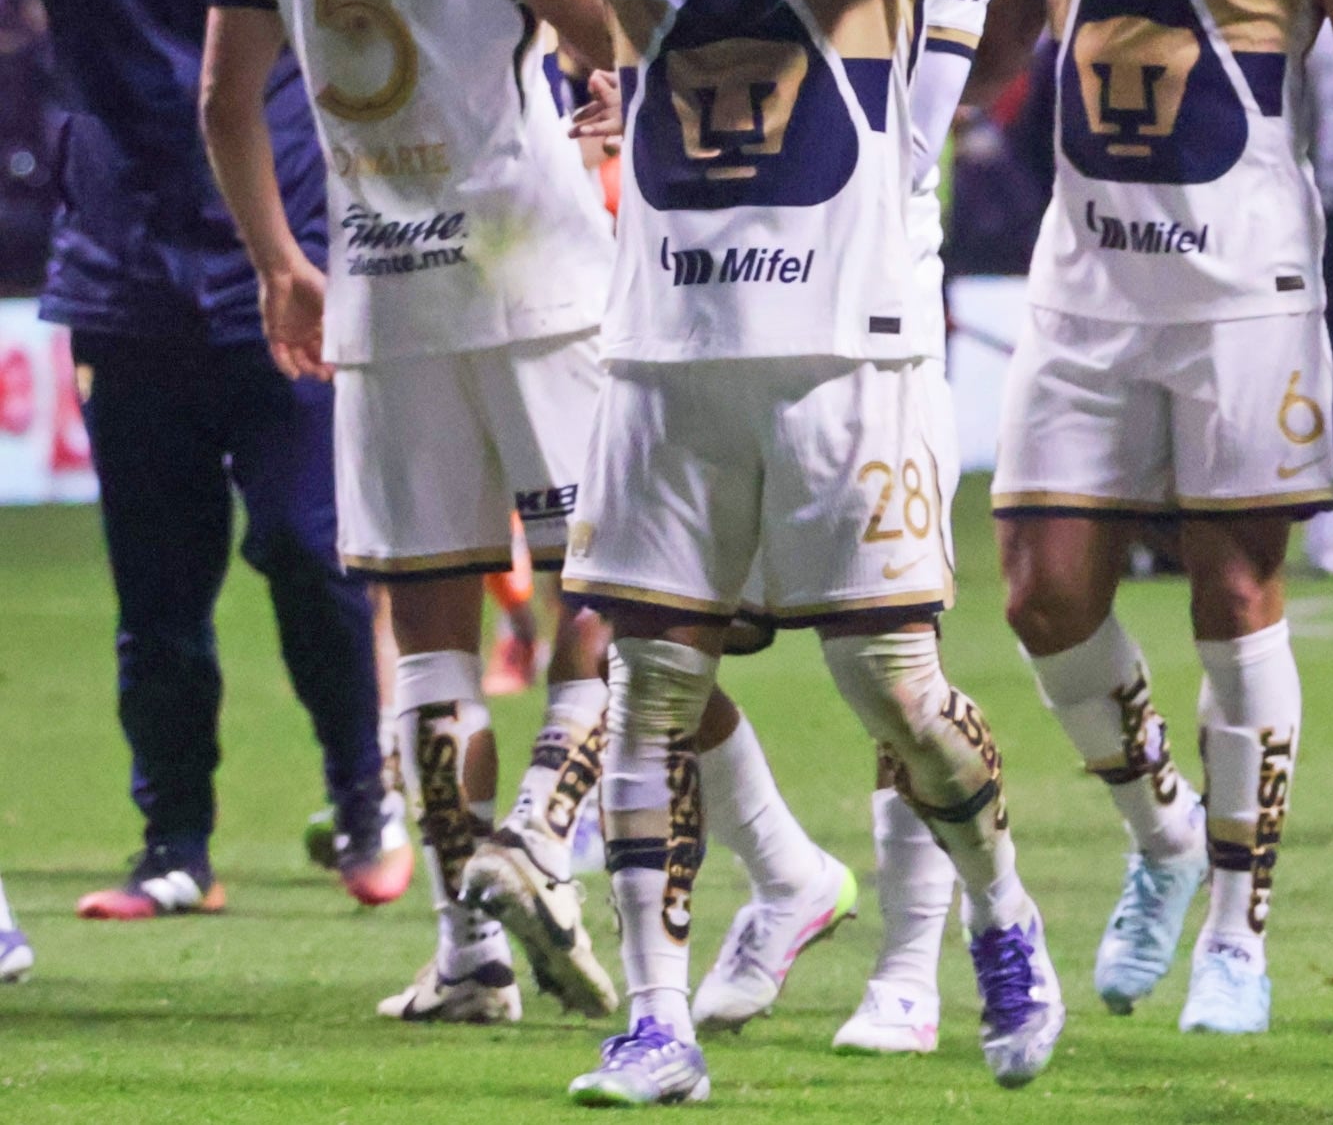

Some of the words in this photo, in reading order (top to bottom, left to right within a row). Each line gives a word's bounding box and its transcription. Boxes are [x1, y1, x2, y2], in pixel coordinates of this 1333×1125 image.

[718, 247, 815, 283] Mifel
[1130, 223, 1208, 255] Mifel
[1276, 371, 1325, 445] 6
[858, 460, 930, 543] 28
